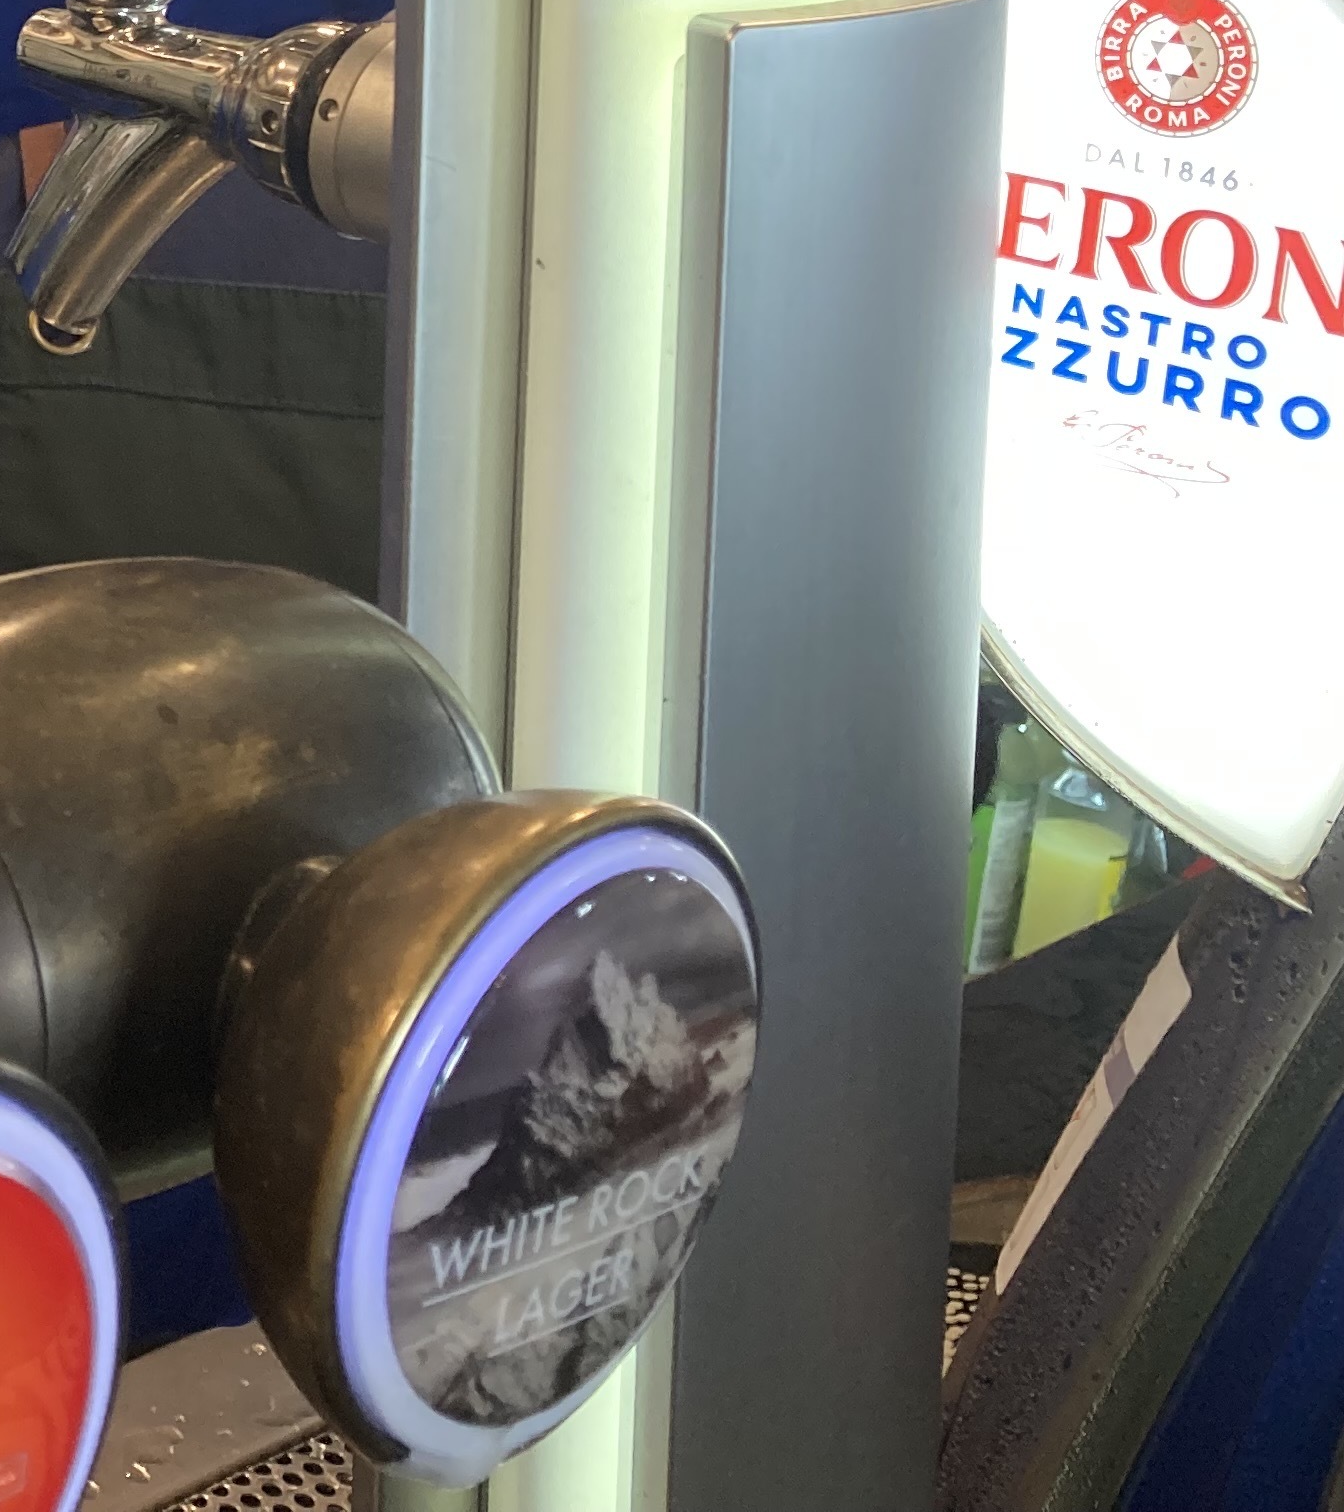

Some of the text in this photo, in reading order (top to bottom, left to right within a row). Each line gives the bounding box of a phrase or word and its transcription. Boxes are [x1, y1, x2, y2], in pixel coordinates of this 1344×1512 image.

[1103, 0, 1249, 107] BIRRA PERONI
[1084, 140, 1146, 176] DAL
[1124, 93, 1211, 128] ROMA
[1011, 282, 1269, 371] NASTRO
[1000, 325, 1332, 441] ZZURRO
[428, 1152, 705, 1289] WHITE ROCK
[493, 1246, 635, 1342] LAGER
